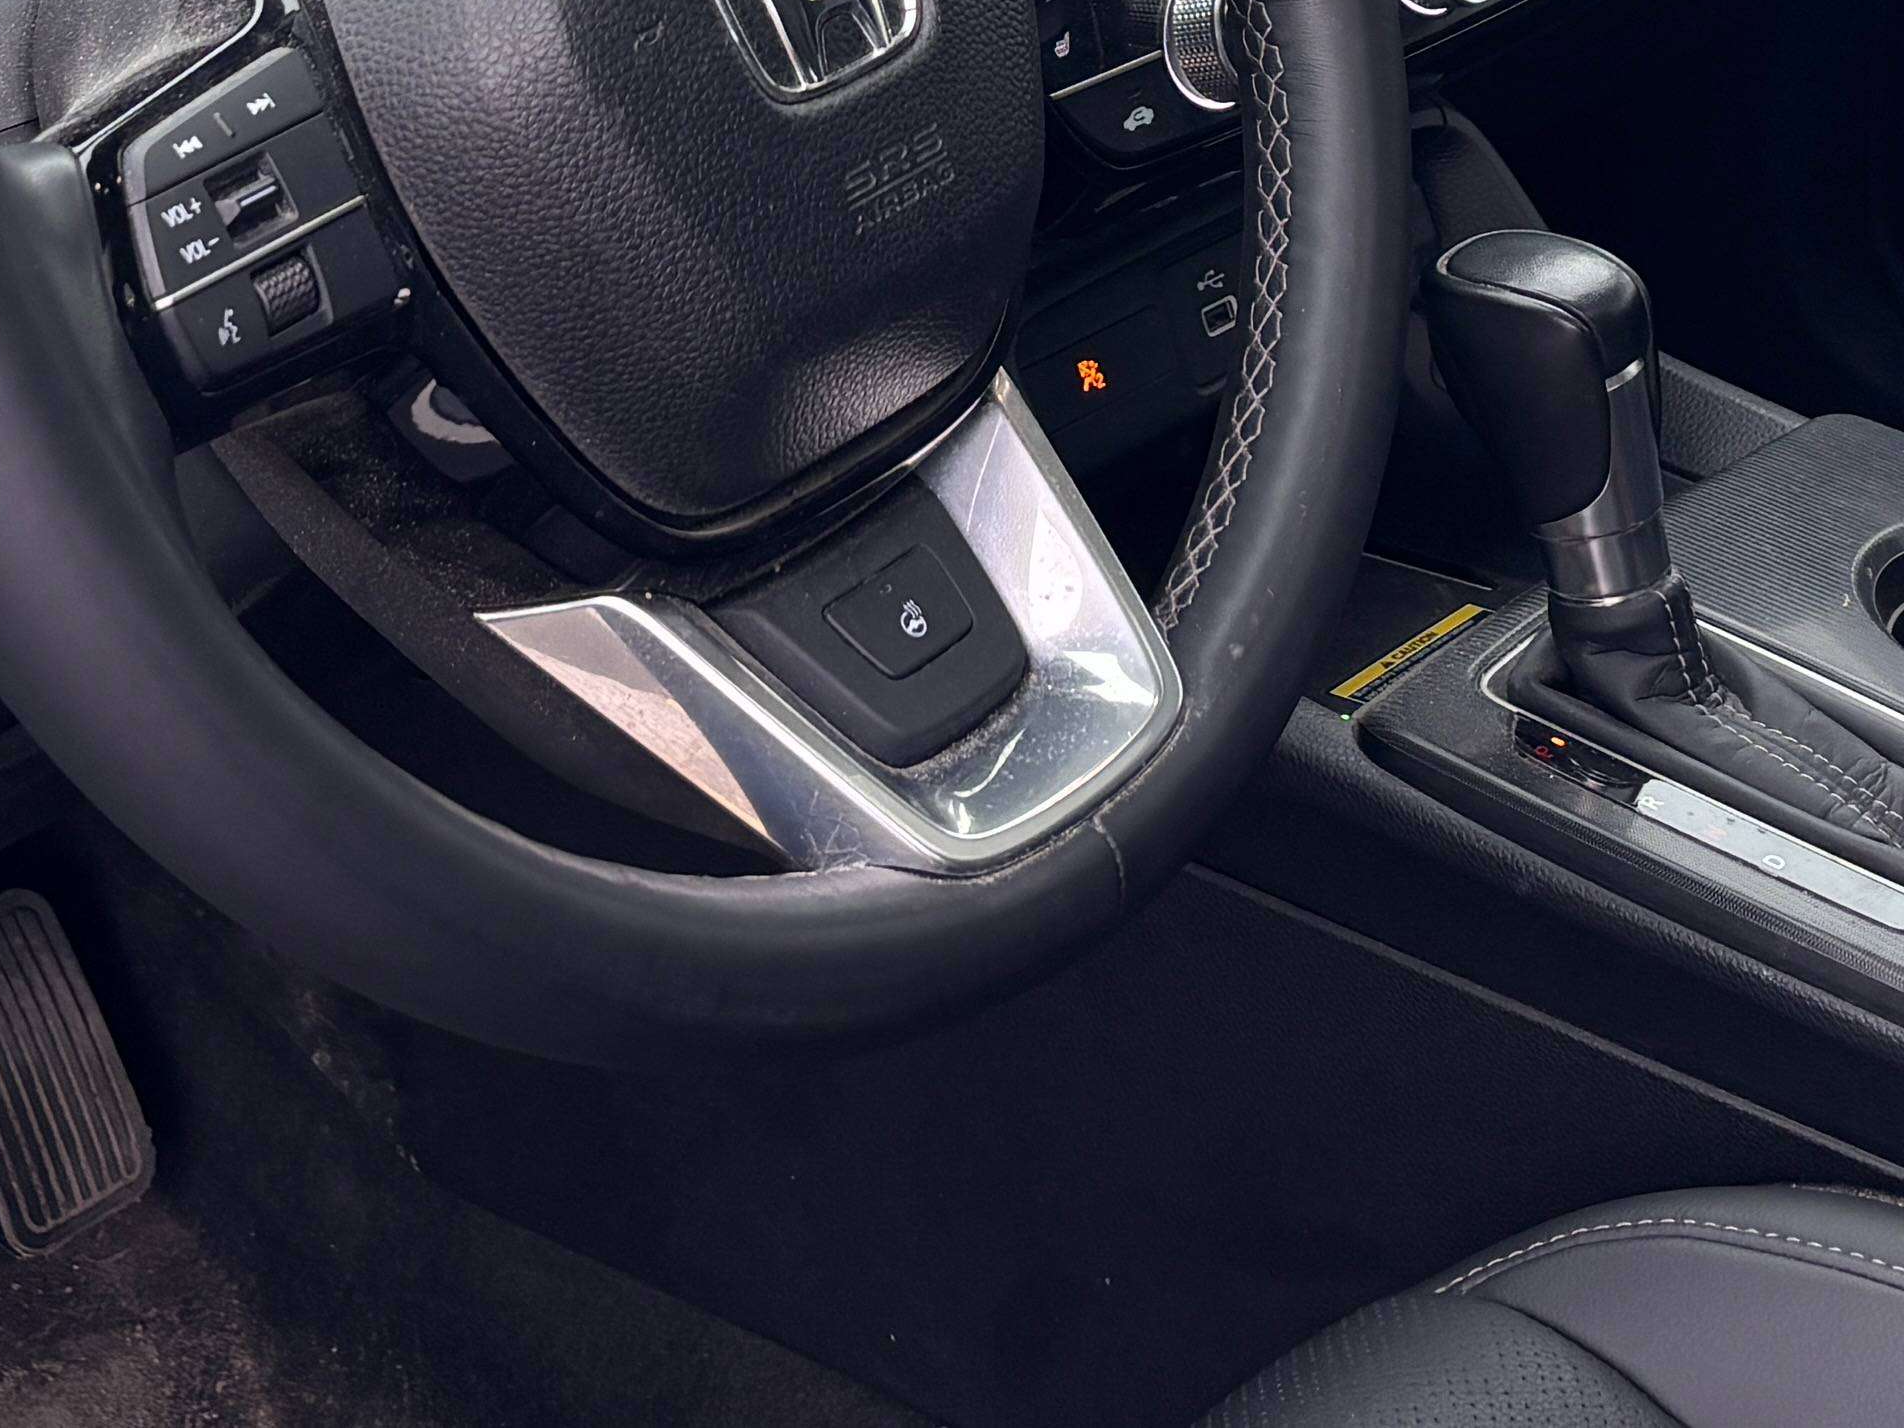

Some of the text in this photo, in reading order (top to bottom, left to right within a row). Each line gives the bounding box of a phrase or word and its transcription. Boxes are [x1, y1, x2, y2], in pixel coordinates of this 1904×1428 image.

[845, 122, 945, 202] SRS
[856, 162, 956, 236] AIRBAG
[1391, 630, 1440, 662] CAUTION
[1639, 794, 1665, 812] R
[1762, 853, 1787, 871] D
